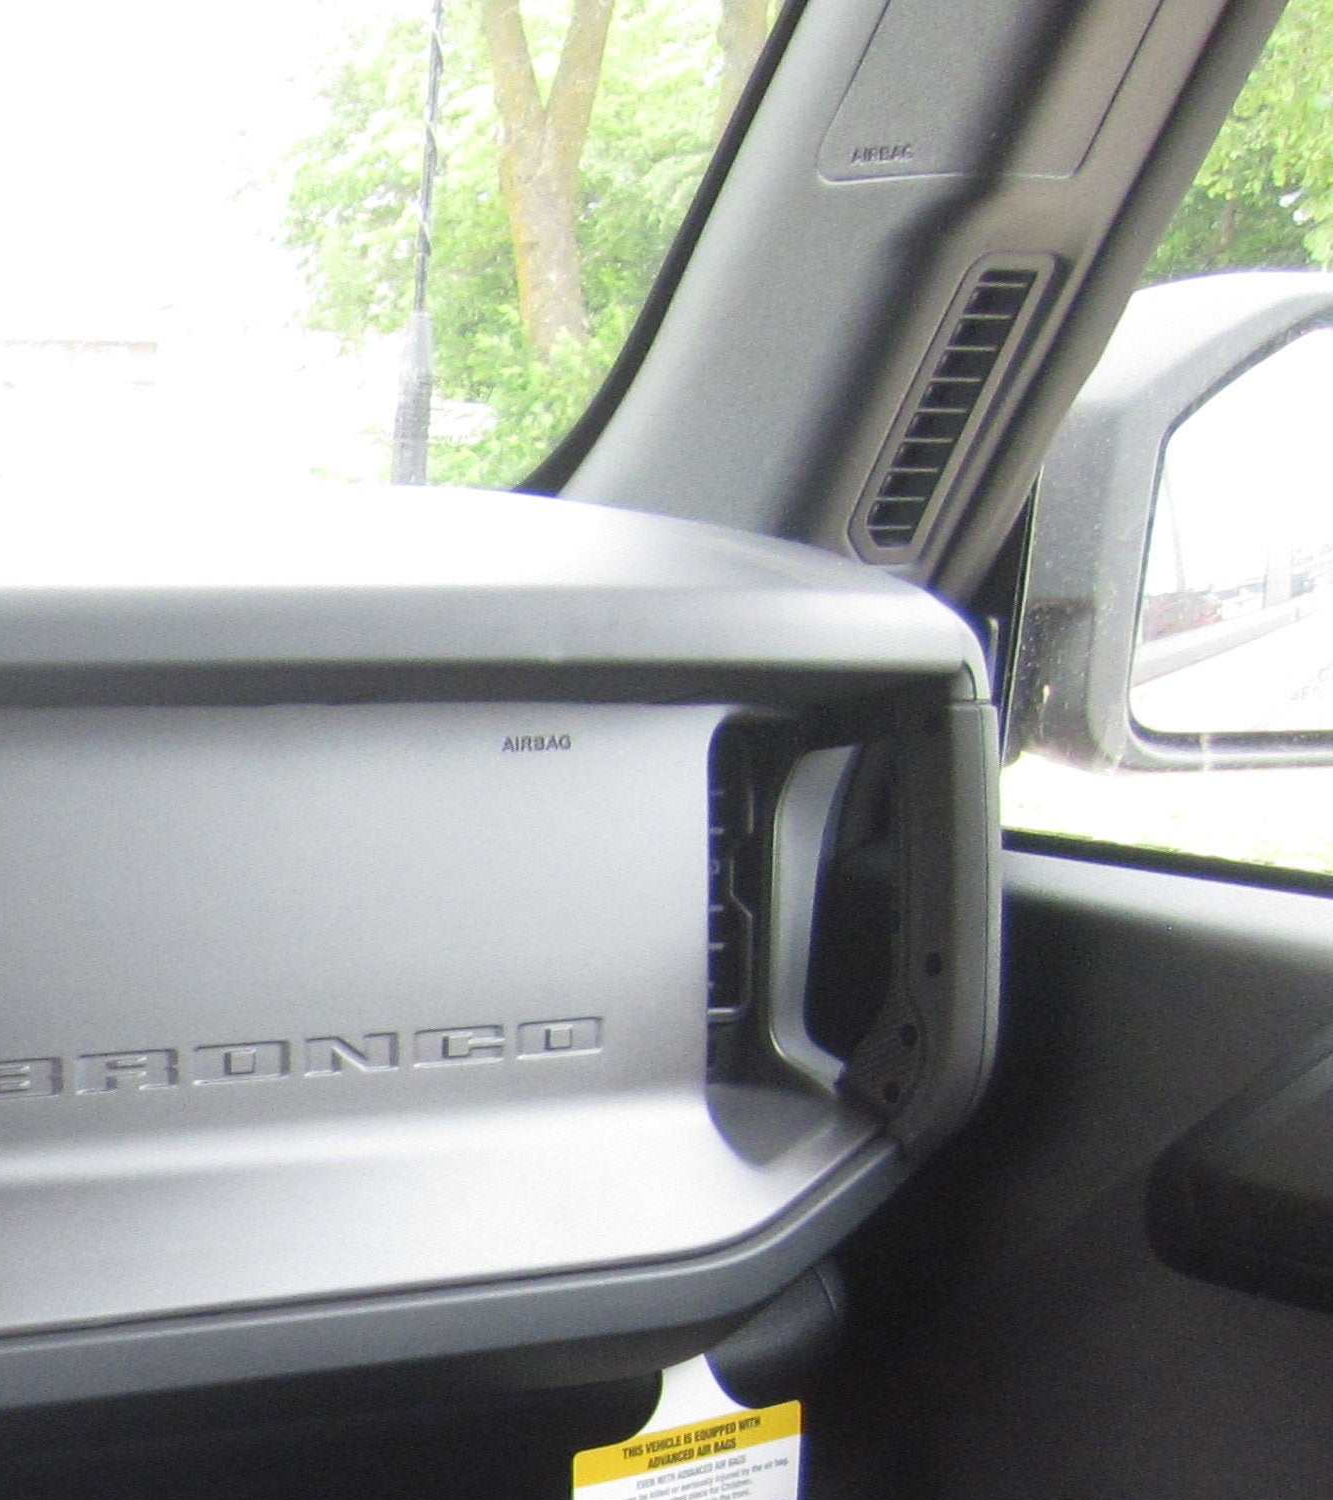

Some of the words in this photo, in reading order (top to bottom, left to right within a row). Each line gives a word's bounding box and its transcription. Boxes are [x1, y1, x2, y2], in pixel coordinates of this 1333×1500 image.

[501, 734, 572, 752] AIRBAG
[623, 1445, 643, 1459] THIS
[646, 1436, 682, 1454] VEHICLE
[684, 1434, 693, 1445] IS
[694, 1422, 736, 1443] EQUIPPED
[739, 1417, 760, 1432] WITH
[648, 1450, 694, 1469] ADVANCED
[697, 1445, 711, 1458] AIR
[713, 1438, 737, 1454] BAGS
